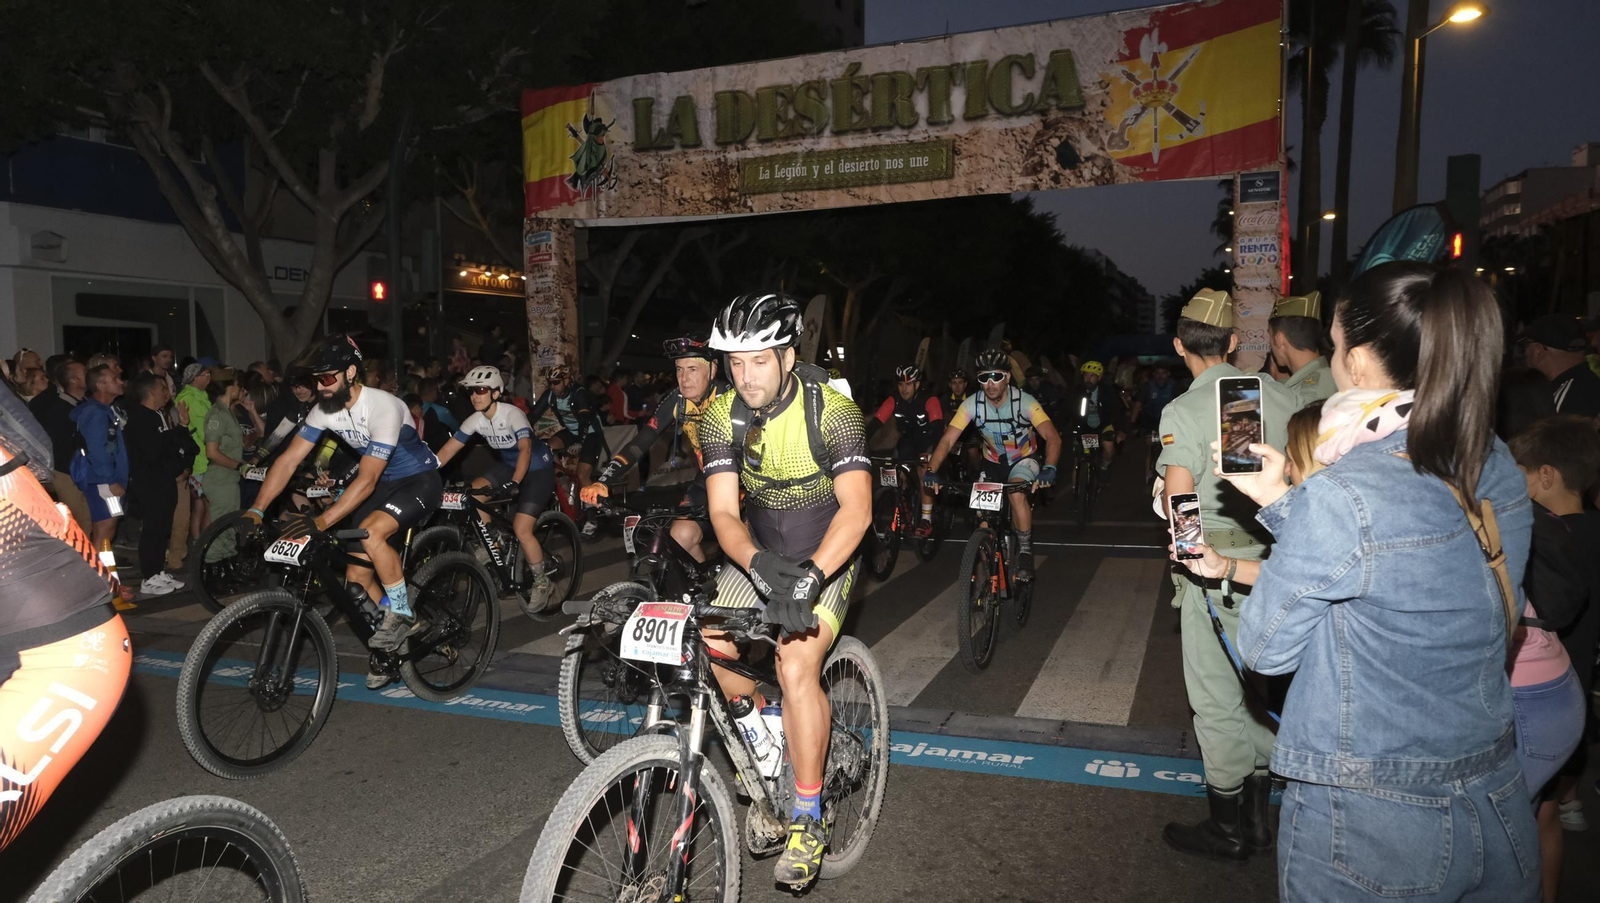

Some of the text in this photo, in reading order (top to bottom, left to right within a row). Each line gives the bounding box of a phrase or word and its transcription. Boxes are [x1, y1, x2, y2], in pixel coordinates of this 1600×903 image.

[633, 48, 1087, 151] LA DESÉRTICA
[758, 156, 929, 181] La Legión y el desierto nos une
[1240, 236, 1277, 244] GRUPO
[1240, 243, 1278, 254] RENTA
[531, 305, 552, 314] BBVA
[977, 490, 999, 503] 7357
[271, 541, 300, 558] 6620
[632, 617, 679, 646] 8901
[641, 649, 670, 658] cajamar
[889, 742, 1034, 765] ajamar
[945, 756, 1025, 770] CAJA RURAL
[1153, 770, 1206, 788] ca
